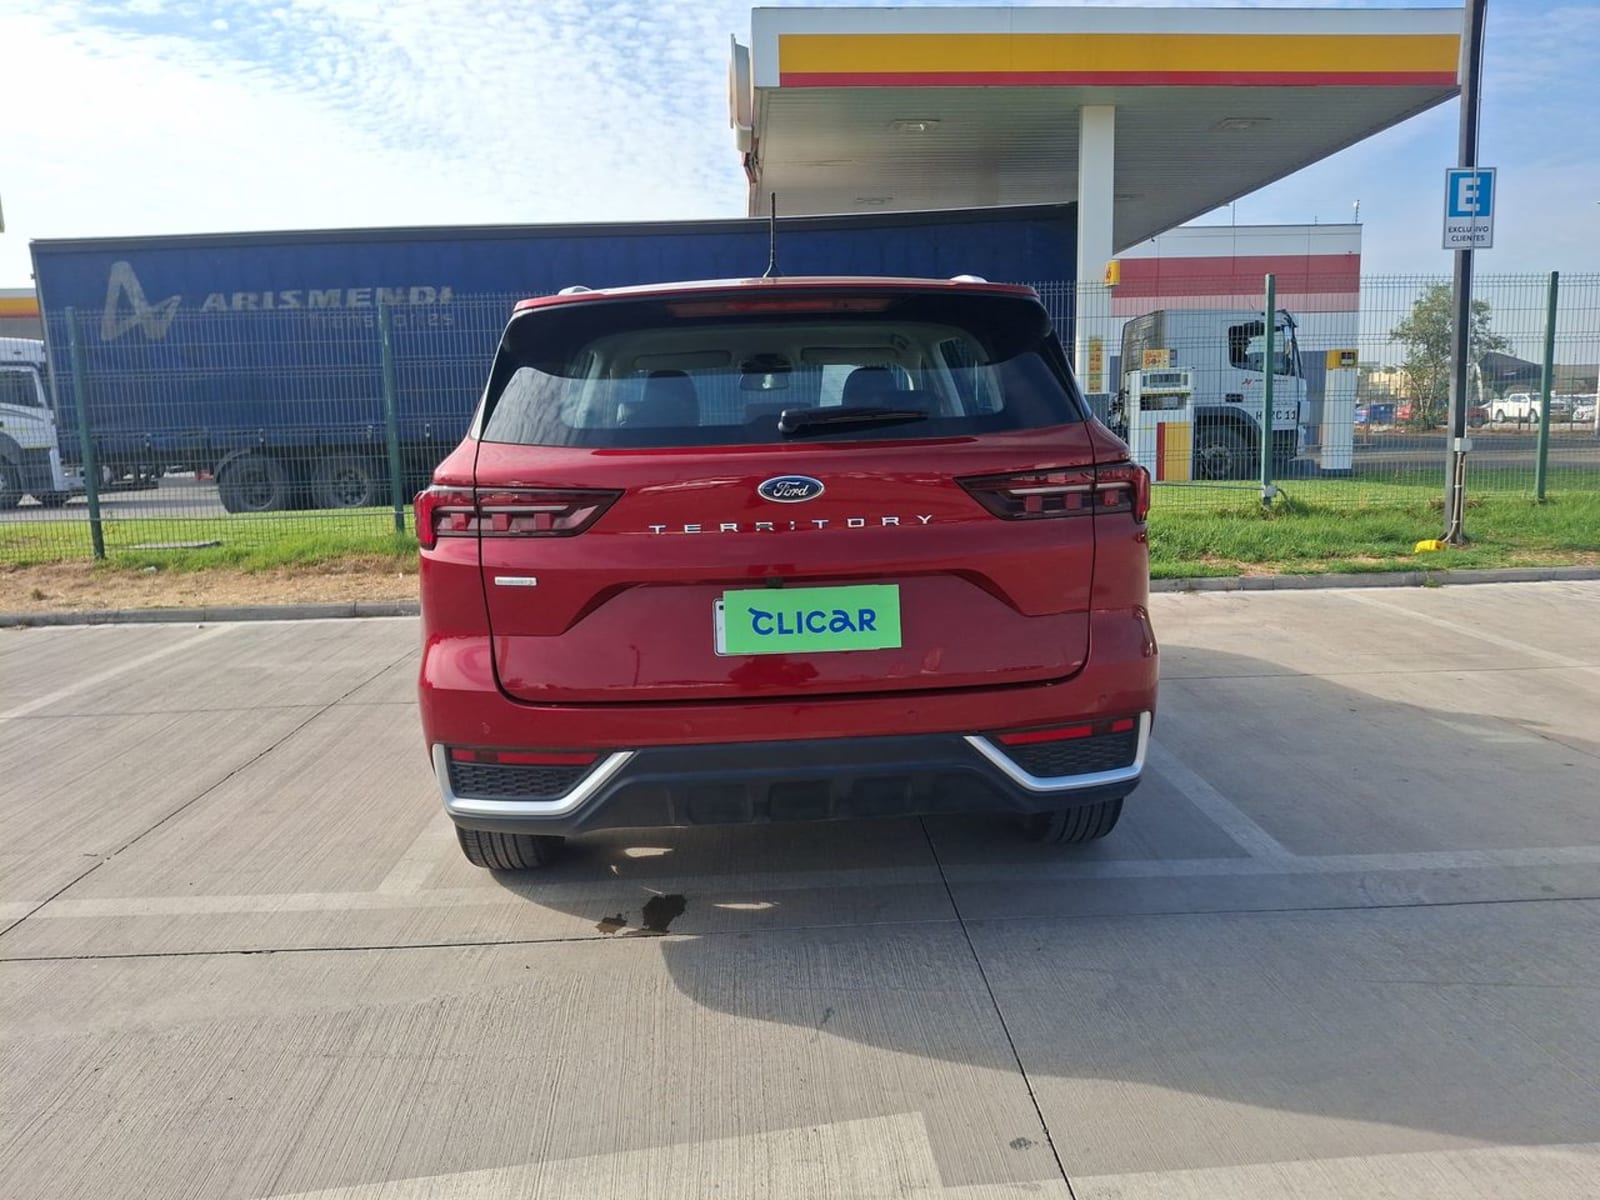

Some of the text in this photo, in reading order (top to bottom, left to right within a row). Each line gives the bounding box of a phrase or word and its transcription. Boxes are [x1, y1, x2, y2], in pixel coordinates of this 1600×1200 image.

[1458, 177, 1480, 212] E
[201, 286, 454, 312] ARISMENDI
[1255, 411, 1282, 420] HC
[773, 481, 809, 497] Ford
[649, 514, 933, 534] TERRITORY
